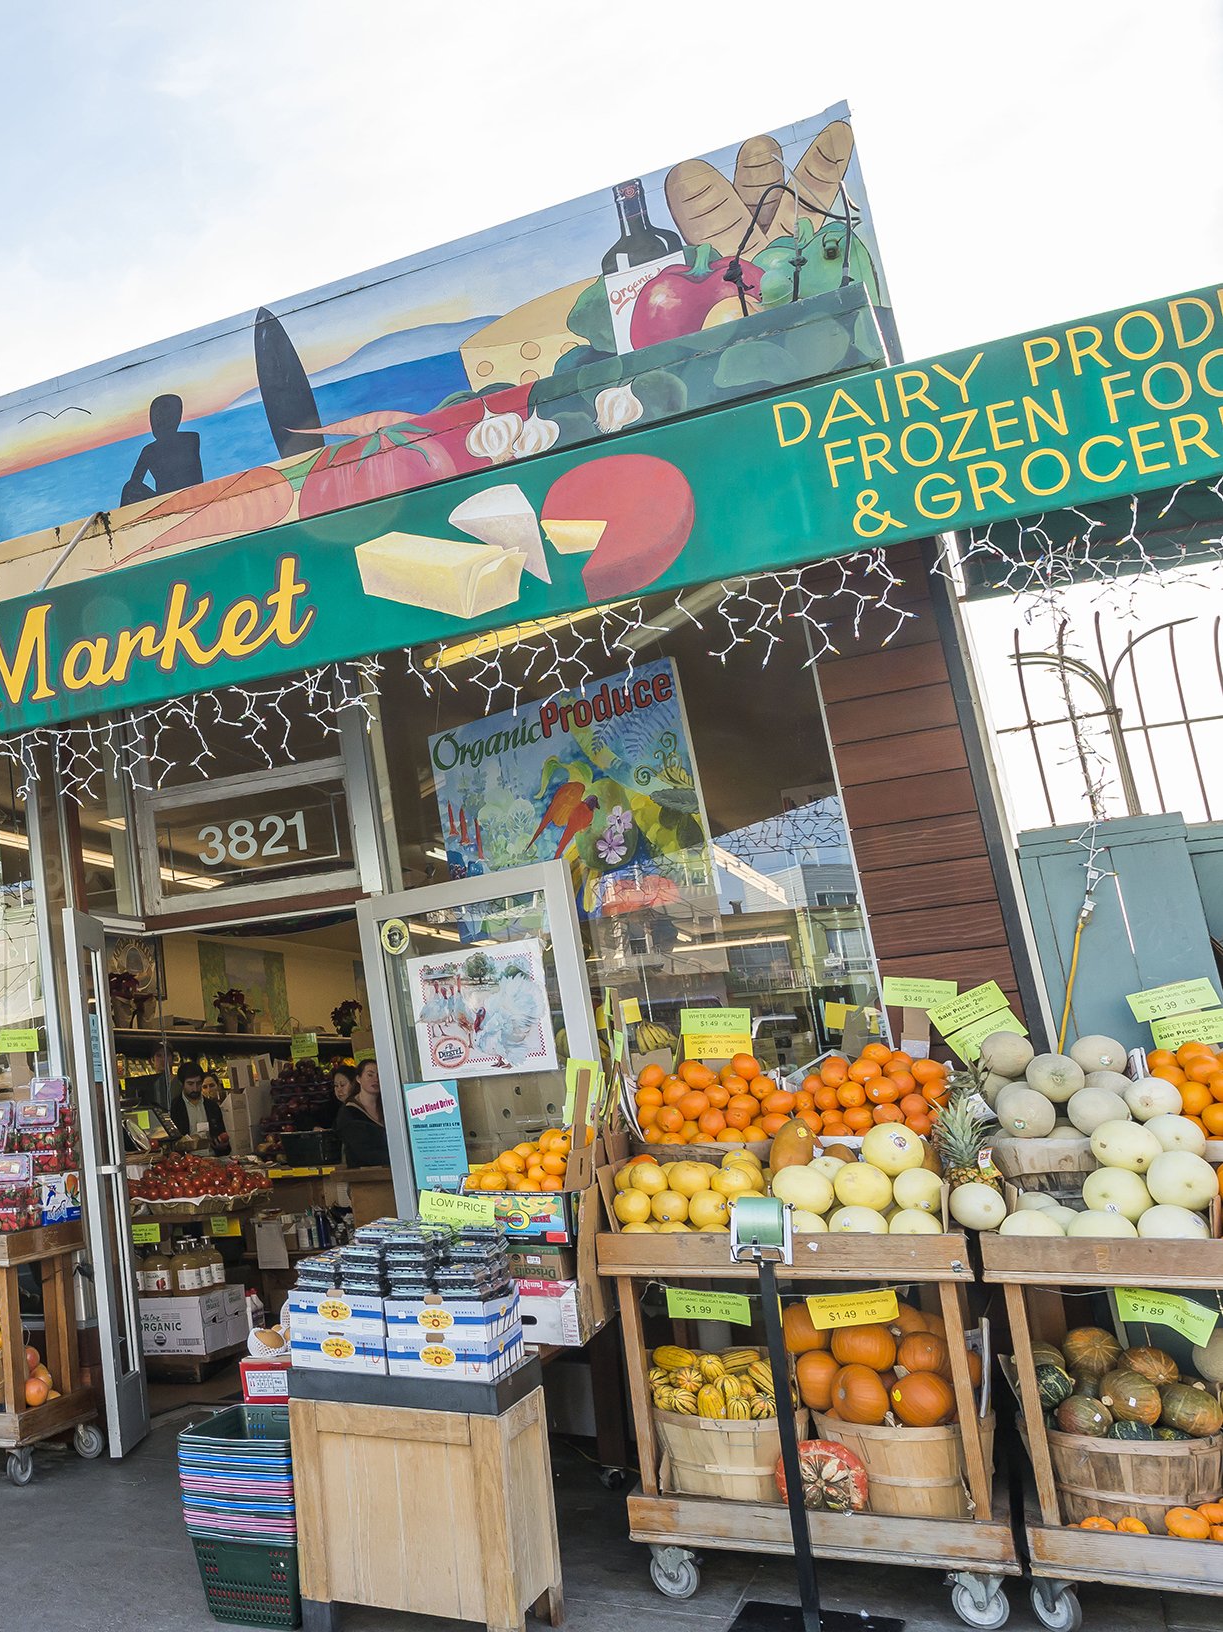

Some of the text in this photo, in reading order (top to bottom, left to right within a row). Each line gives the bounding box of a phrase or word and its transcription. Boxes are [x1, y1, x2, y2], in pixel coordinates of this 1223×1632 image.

[610, 271, 654, 305] Organic
[772, 287, 1223, 448] DAIRY PROD
[823, 389, 1069, 488] FROZEN
[853, 406, 1223, 538] & GROCER
[540, 673, 673, 738] Produce
[198, 810, 308, 866] 3821
[904, 994, 922, 1003] $3.49
[934, 995, 970, 1015] HONEYDEW
[969, 985, 992, 1001] MELON
[1135, 989, 1164, 998] CALIFORNIA
[1138, 996, 1164, 1005] HEIRLOOM
[1181, 986, 1207, 995] ORANGES
[937, 1011, 953, 1022] Sale
[952, 1003, 972, 1014] Price:
[1150, 1000, 1178, 1014] $1.39
[959, 1018, 1012, 1049] SWEET CANTALOUPES
[1157, 1023, 1181, 1034] SWEET
[1158, 1031, 1175, 1040] Sale
[1176, 1027, 1200, 1035] Price:
[698, 1047, 718, 1055] $1.49
[410, 1098, 455, 1116] Local Blood Drive
[430, 1197, 487, 1214] LOW PRICE
[685, 1305, 712, 1314] $1.99
[829, 1310, 857, 1322] $1.49
[1124, 1294, 1206, 1323] ORGANIC KABOCHA SQUASH
[1131, 1303, 1165, 1316] $1.89
